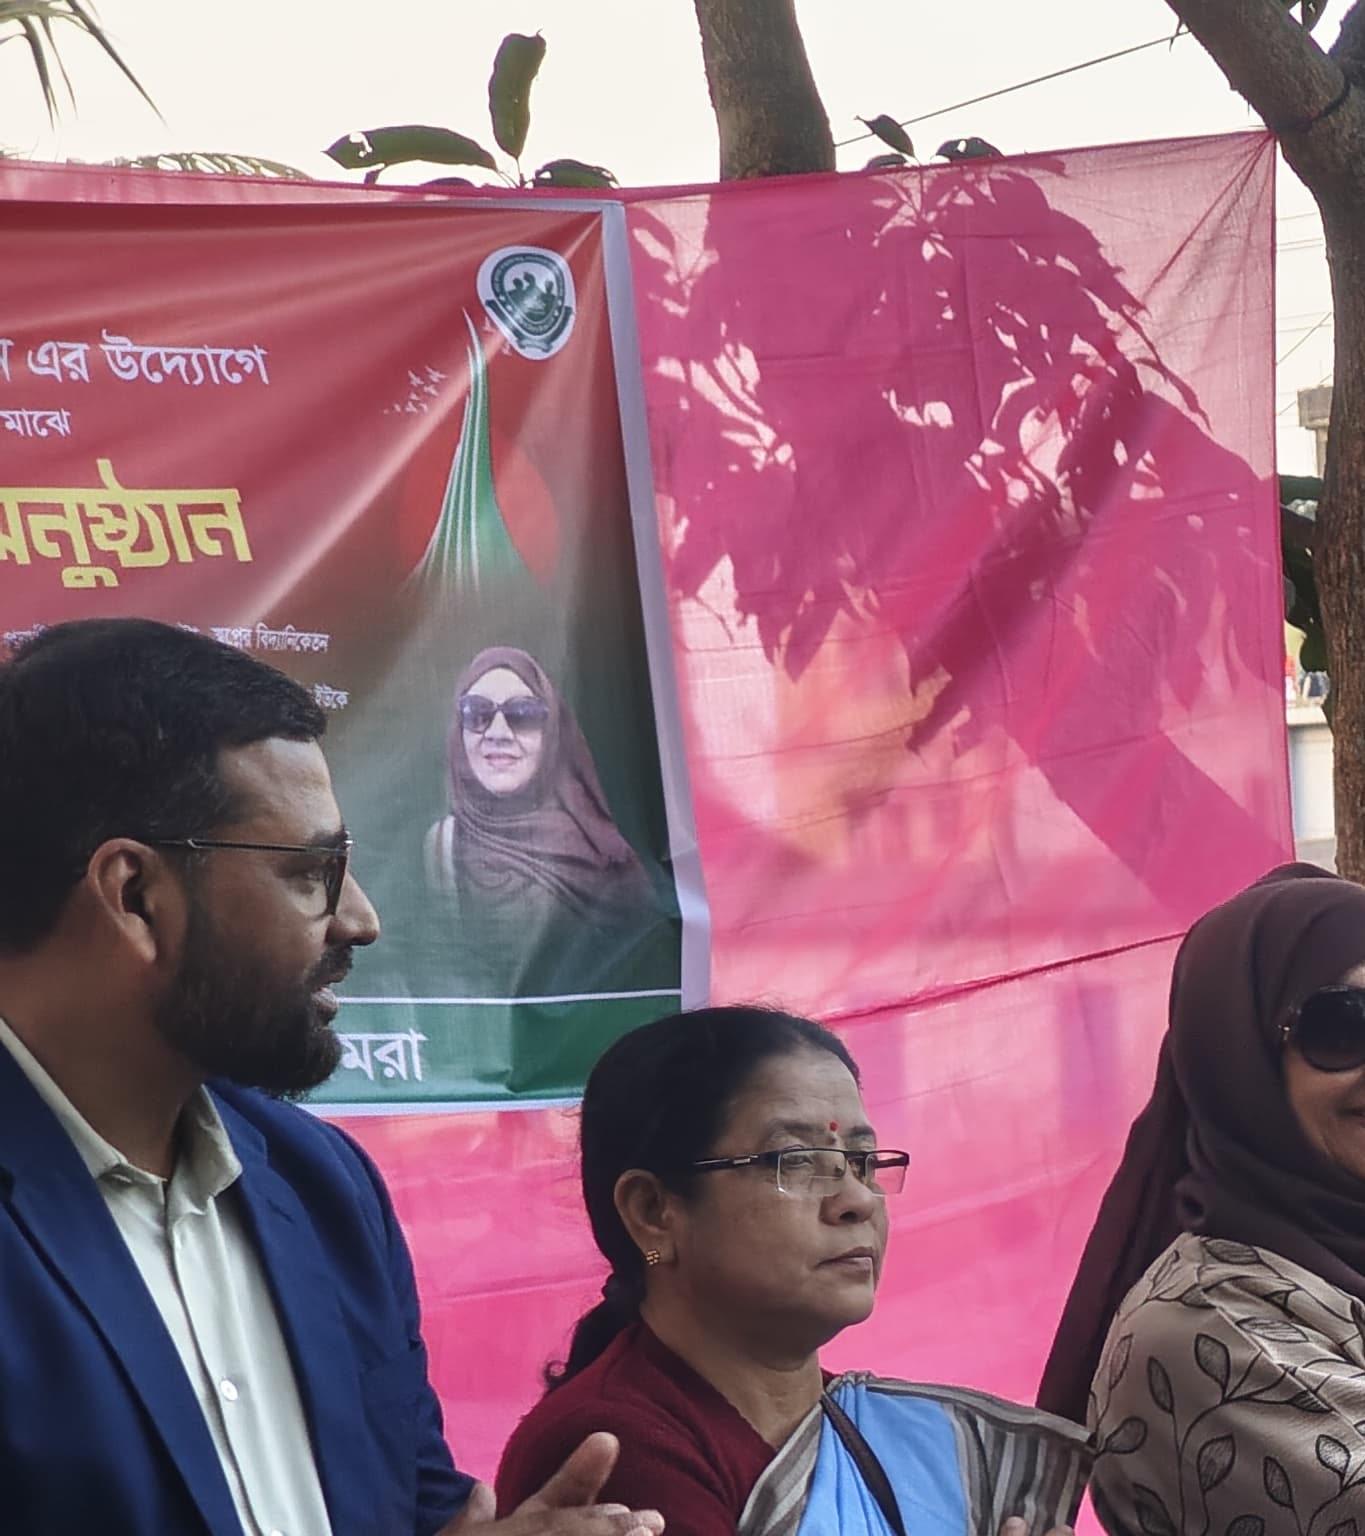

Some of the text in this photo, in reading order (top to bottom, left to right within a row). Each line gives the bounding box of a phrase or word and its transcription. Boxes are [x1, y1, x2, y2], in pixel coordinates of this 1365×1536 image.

[27, 341, 90, 383] এর
[99, 328, 269, 385] উদ্যোগে
[336, 1027, 430, 1082] মরা
